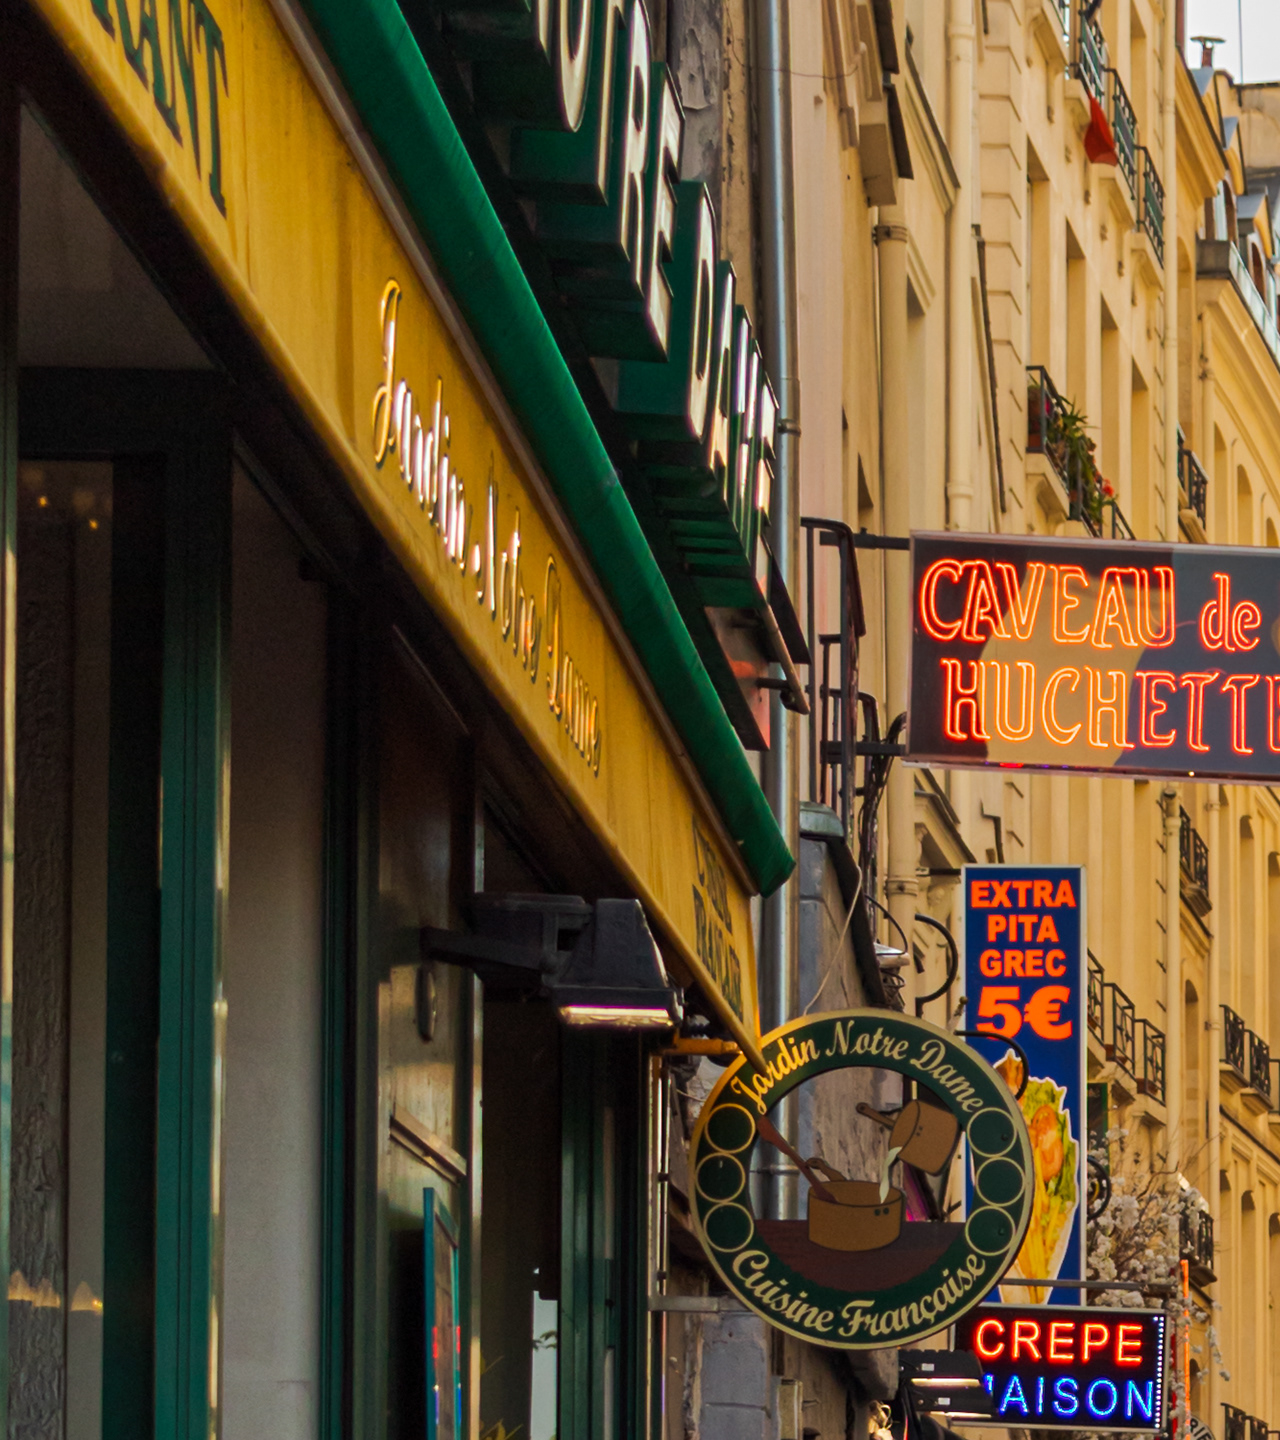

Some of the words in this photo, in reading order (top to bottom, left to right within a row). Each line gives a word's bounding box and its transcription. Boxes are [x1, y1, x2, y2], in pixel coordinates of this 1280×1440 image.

[919, 558, 1175, 650] CAVEAU
[1200, 573, 1263, 652] de
[970, 880, 1076, 910] EXTRA
[987, 914, 1060, 943] PITA
[979, 949, 1068, 978] GREC
[976, 985, 1073, 1040] 5€
[730, 1035, 820, 1115] Jardin
[825, 1020, 909, 1061] Notre
[909, 1037, 985, 1114] Dame
[732, 1249, 835, 1334] Cuisine
[838, 1253, 986, 1339] Française
[976, 1319, 1144, 1364] CREPE
